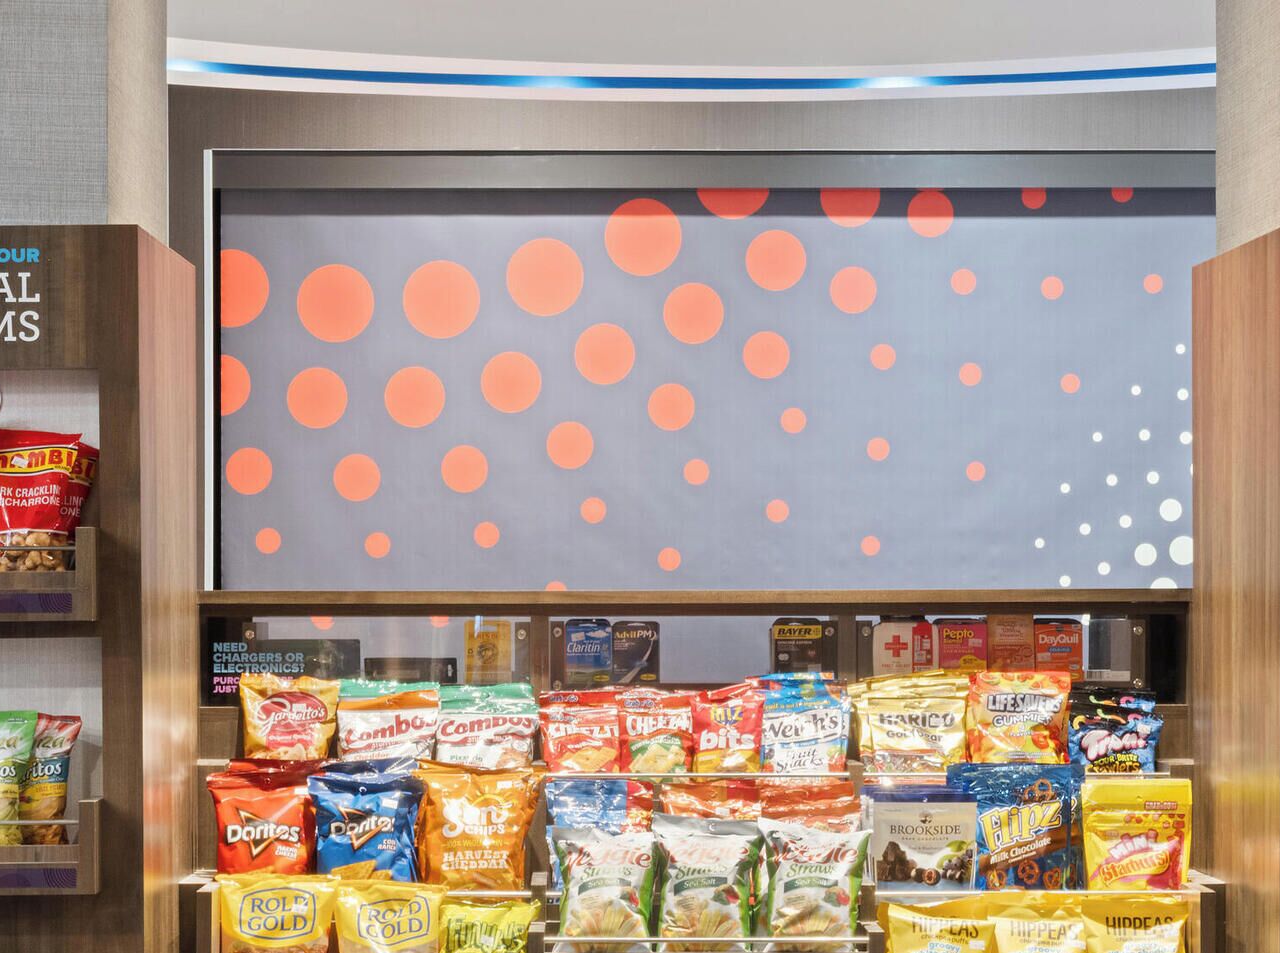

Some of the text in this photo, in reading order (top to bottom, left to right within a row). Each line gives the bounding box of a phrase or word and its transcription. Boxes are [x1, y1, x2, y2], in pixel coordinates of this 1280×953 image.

[614, 630, 652, 639] Advil PM
[777, 627, 812, 636] BAYER
[943, 628, 974, 640] Pepto
[1039, 633, 1079, 646] DayQuil
[213, 642, 248, 652] NEED
[567, 642, 601, 653] Claritin
[213, 653, 304, 662] CHARGERS OR
[213, 663, 305, 673] ELECTRONICS?
[213, 685, 237, 693] JUST
[700, 731, 756, 750] bits
[890, 823, 962, 838] BROOKSIDE
[979, 799, 1062, 855] Flipz
[226, 822, 301, 846] Doritos
[442, 850, 510, 862] HARVEST
[989, 848, 1008, 865] Milk
[1009, 836, 1053, 857] Chocolate
[441, 860, 508, 871] CHEDDAR
[366, 900, 422, 923] ROLD
[247, 914, 308, 932] GOLD
[365, 916, 425, 939] GOLD
